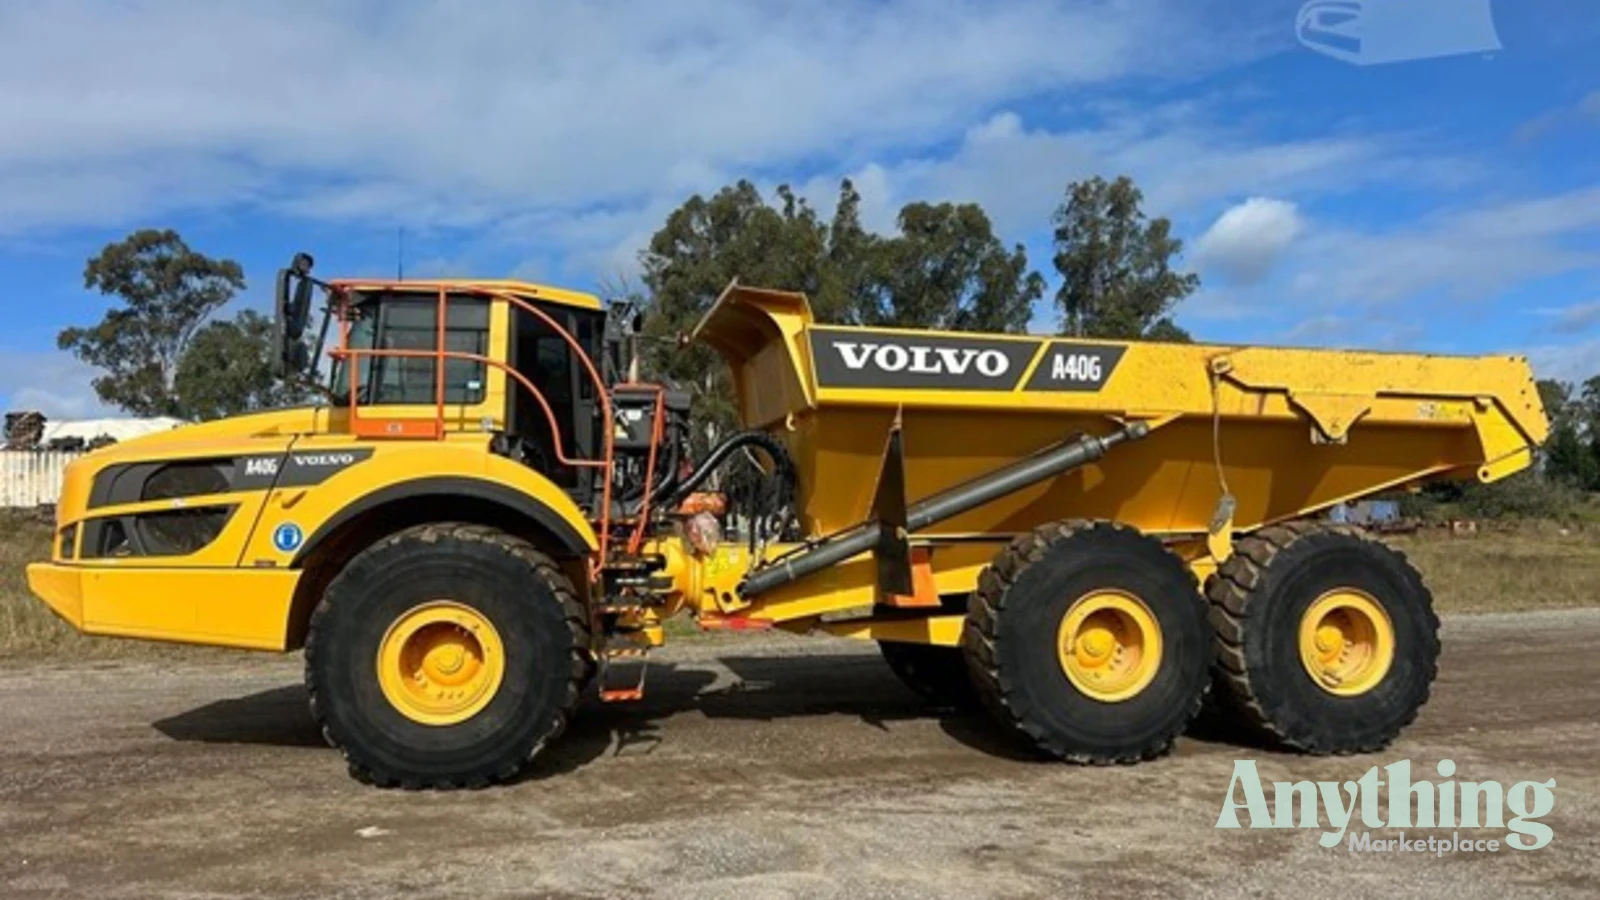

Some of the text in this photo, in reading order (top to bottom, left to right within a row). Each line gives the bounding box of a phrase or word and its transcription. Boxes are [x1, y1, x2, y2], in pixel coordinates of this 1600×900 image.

[832, 341, 1102, 381] VOLVO A40G
[294, 453, 355, 466] VOLVO
